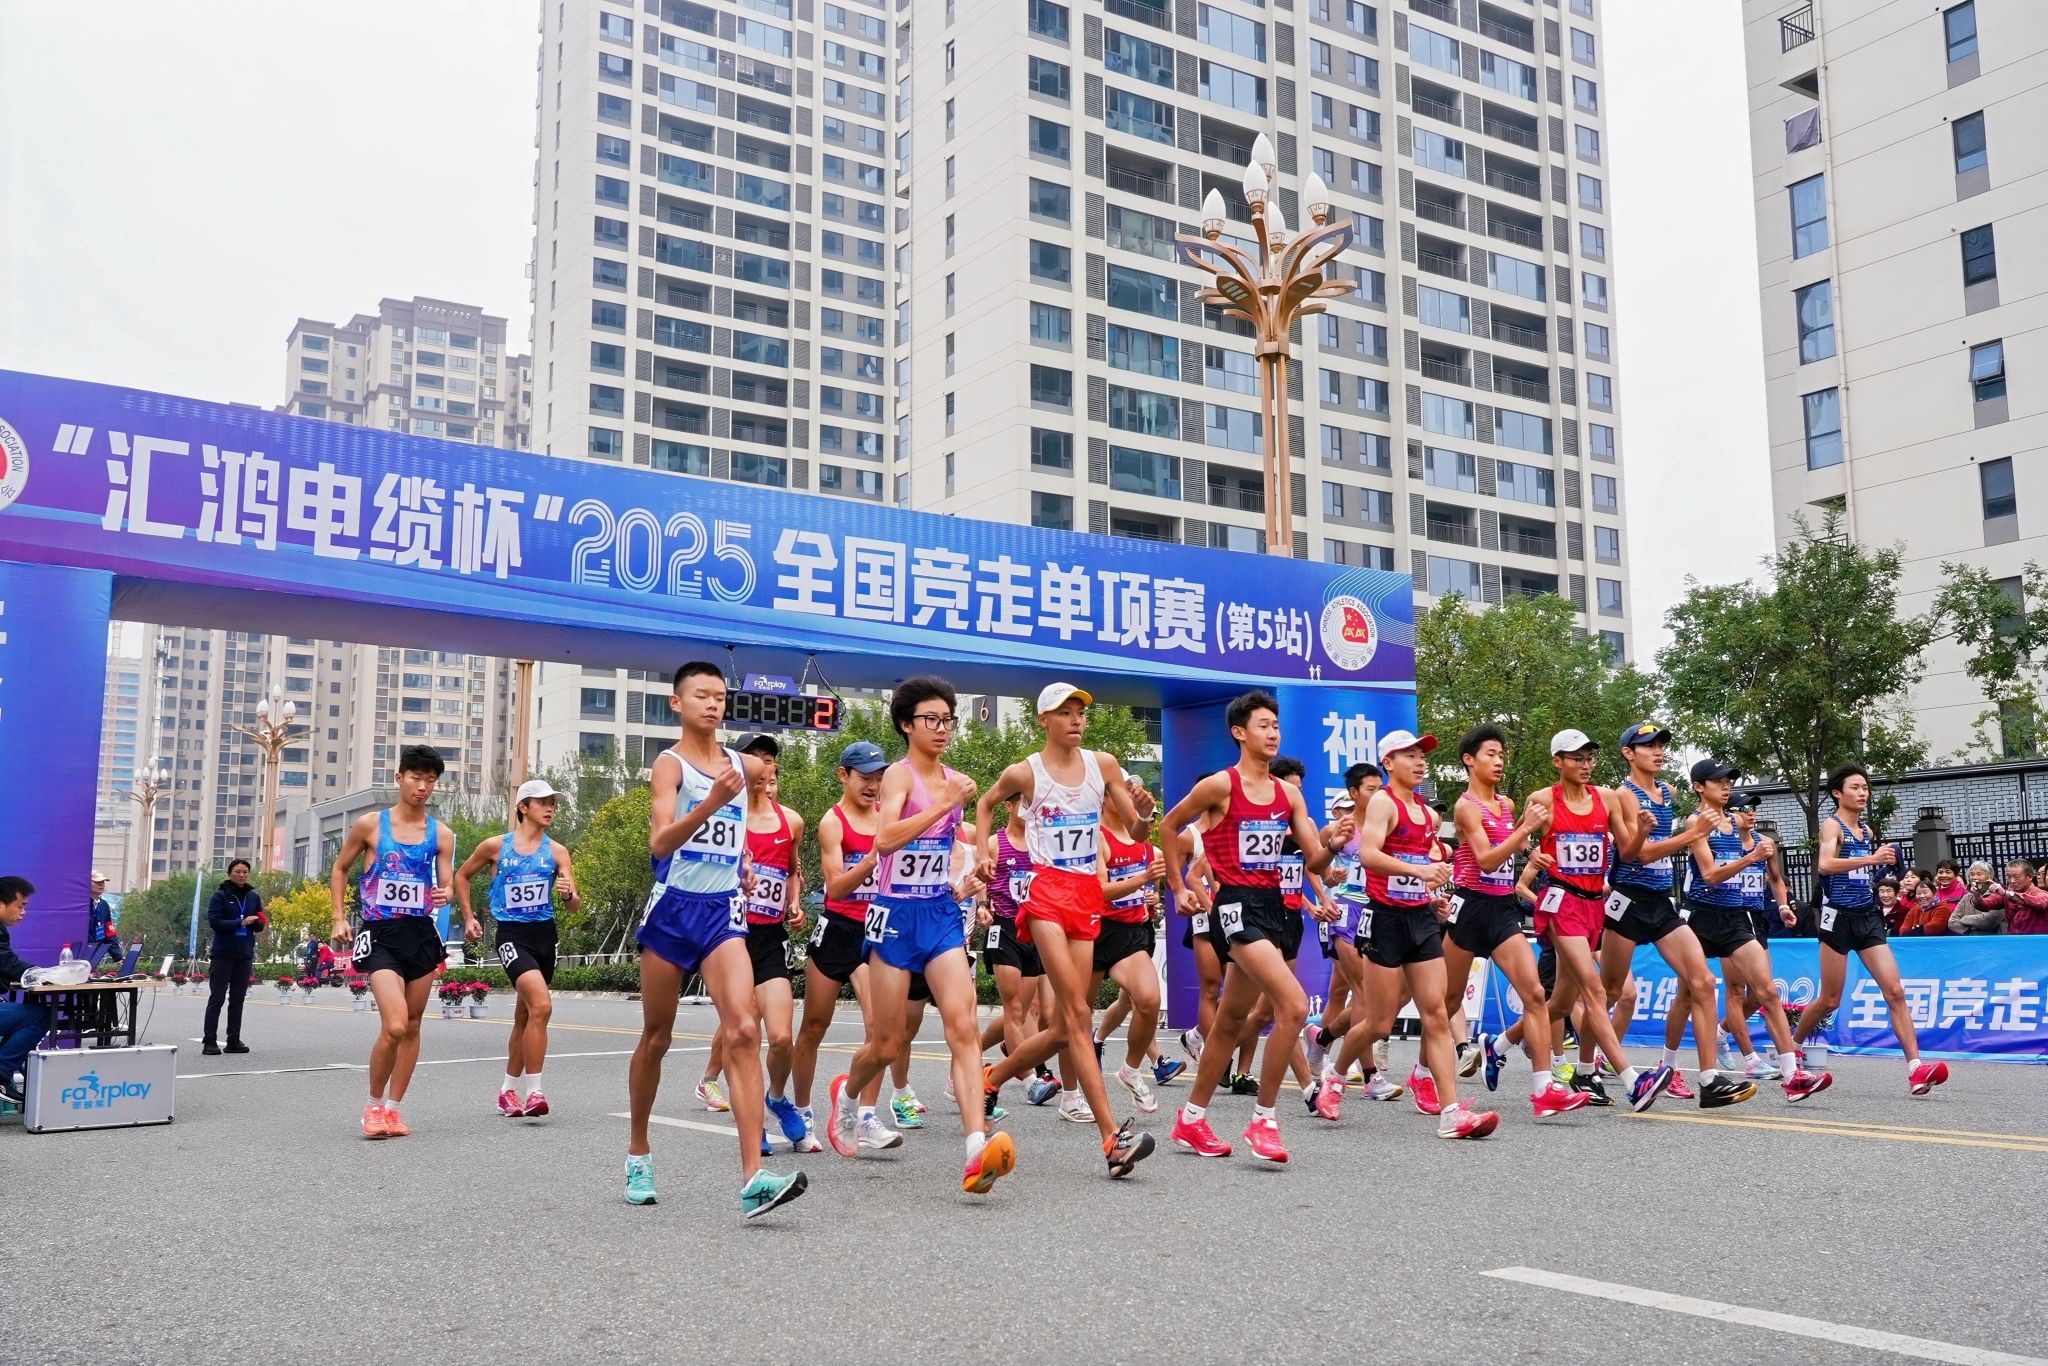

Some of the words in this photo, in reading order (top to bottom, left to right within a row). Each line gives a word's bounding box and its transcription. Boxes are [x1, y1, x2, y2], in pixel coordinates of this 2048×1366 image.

[568, 499, 756, 606] 2025
[773, 529, 1206, 655] 全国竞走单项赛
[1216, 601, 1313, 662] (第5站)
[980, 698, 989, 721] 6
[691, 820, 736, 849] 281
[1054, 828, 1094, 852] 171
[1245, 834, 1282, 856] 236
[1563, 845, 1600, 862] 138
[900, 854, 943, 878] 374
[384, 882, 419, 903] 361
[511, 884, 545, 903] 357
[751, 879, 782, 902] 38
[1547, 894, 1556, 905] 7
[1610, 900, 1621, 911] 3
[866, 907, 885, 939] 24
[1197, 918, 1204, 928] 9
[1222, 910, 1239, 928] 20
[1823, 913, 1831, 924] 2
[354, 933, 371, 957] 23
[1848, 977, 2048, 1032] 全国竞走
